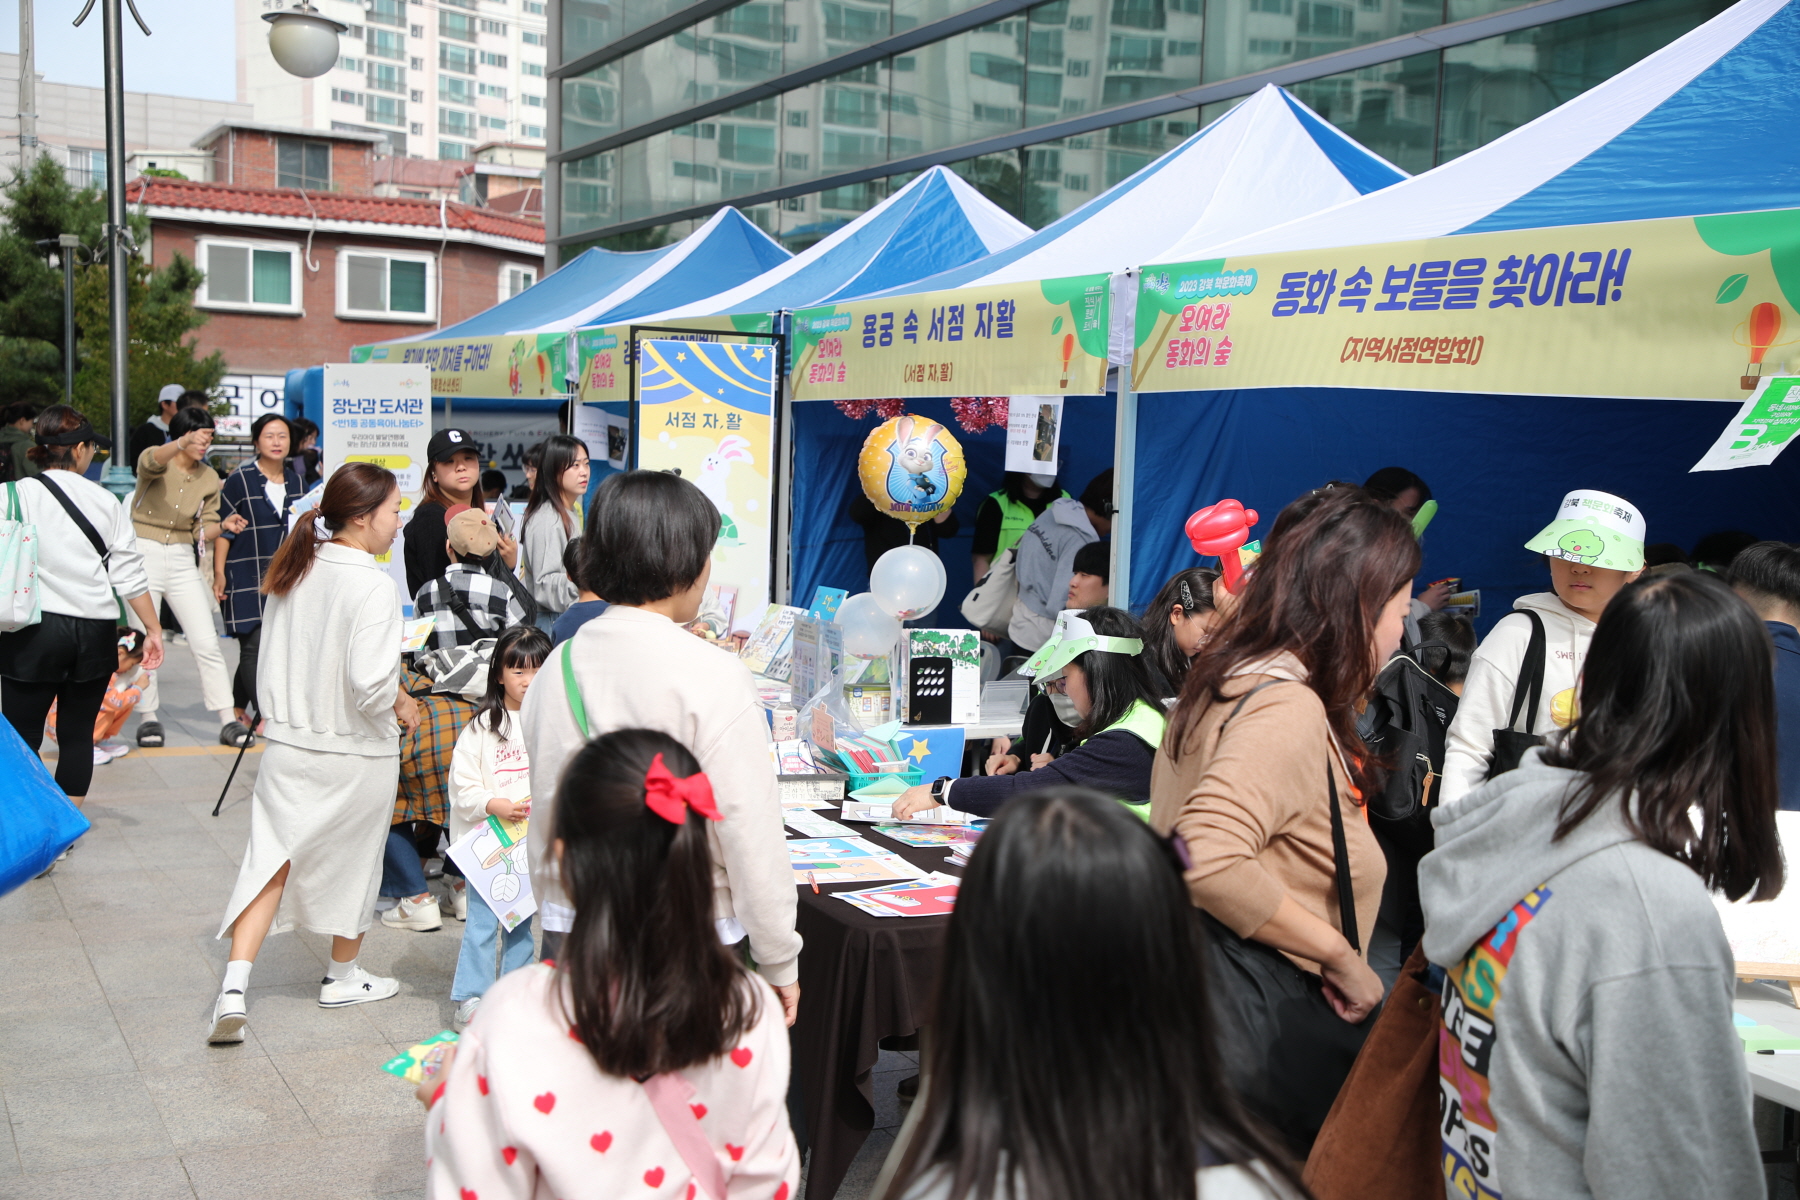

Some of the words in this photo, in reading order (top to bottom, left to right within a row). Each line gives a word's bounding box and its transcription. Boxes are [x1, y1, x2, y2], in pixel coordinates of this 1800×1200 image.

[1178, 280, 1198, 293] 2023
[1199, 278, 1213, 292] 강북
[1215, 274, 1253, 290] 책문화축제
[1272, 268, 1337, 317] 동화
[1338, 265, 1373, 313] 속
[1374, 257, 1487, 312] 보물을
[1488, 248, 1632, 309] 찾아라!
[862, 312, 894, 349] 용궁
[903, 309, 919, 344] 속
[927, 303, 965, 342] 서점
[974, 299, 1015, 339] 자활
[1179, 303, 1231, 333] 모여라
[1166, 337, 1212, 369] 동화의
[1213, 335, 1233, 366] 숲
[1340, 335, 1484, 366] (지역서점연합회)
[809, 362, 835, 384] 동화의
[904, 363, 925, 384] (서점
[333, 398, 377, 414] 장난감
[379, 398, 423, 414] 도서관
[665, 411, 695, 428] 서점
[703, 412, 743, 430] 자,활
[448, 430, 462, 442] C
[889, 503, 910, 512] JOIN
[1563, 498, 1580, 509] 강북
[1582, 498, 1633, 524] 책문화축제
